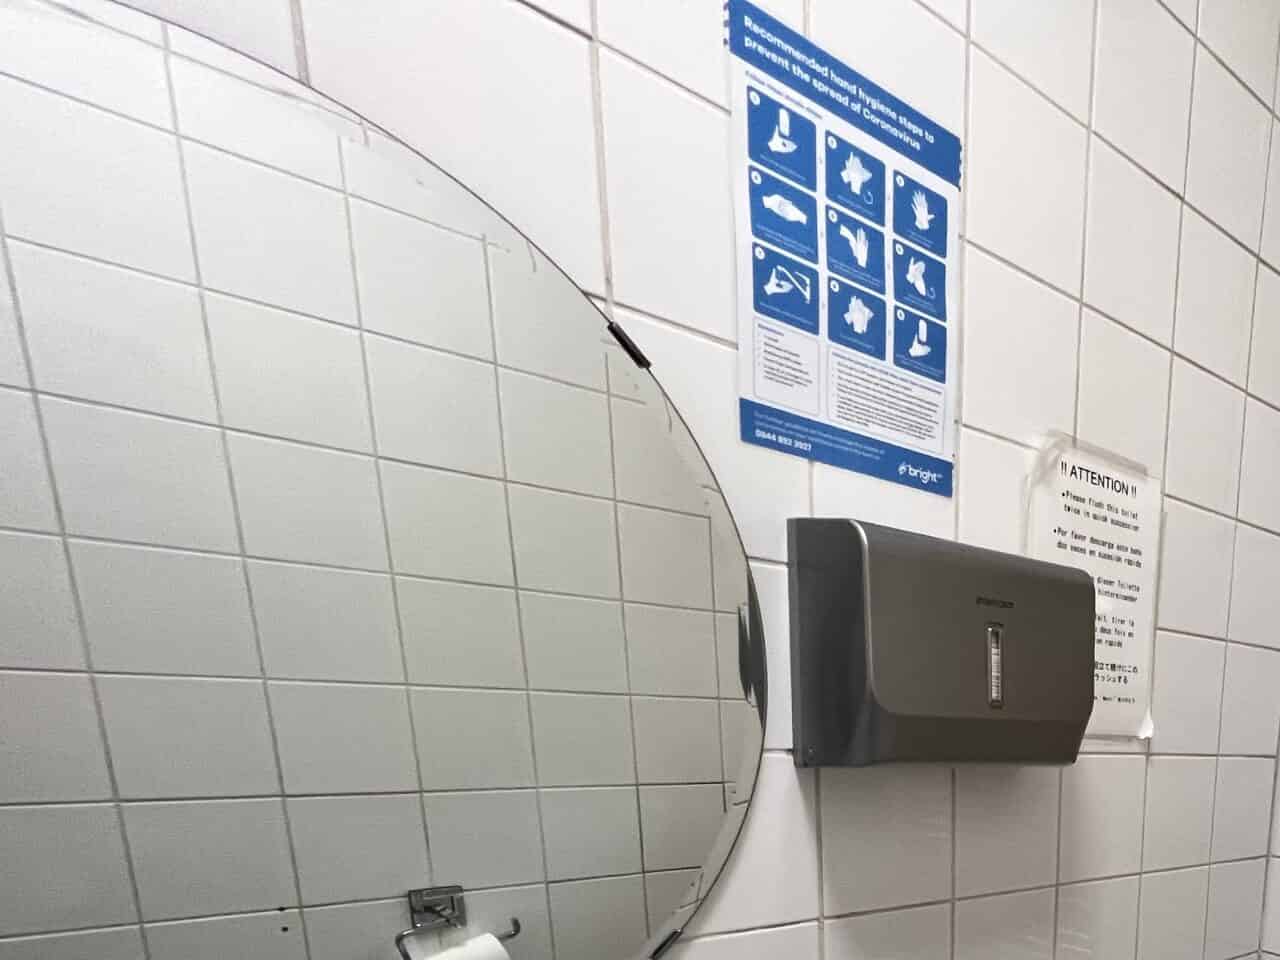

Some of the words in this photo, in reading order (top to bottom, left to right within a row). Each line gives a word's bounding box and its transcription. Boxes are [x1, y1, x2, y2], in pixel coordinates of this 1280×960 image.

[744, 15, 829, 78] Recommended
[830, 69, 857, 96] hand
[859, 87, 897, 121] hygiene
[898, 115, 923, 137] steps
[924, 129, 935, 144] to
[744, 36, 790, 71] prevent
[792, 63, 811, 83] the
[812, 78, 849, 107] spread
[850, 103, 861, 115] of
[862, 107, 920, 150] Coronavirus
[908, 464, 937, 484] bright
[1070, 464, 1129, 496] ATTENTION
